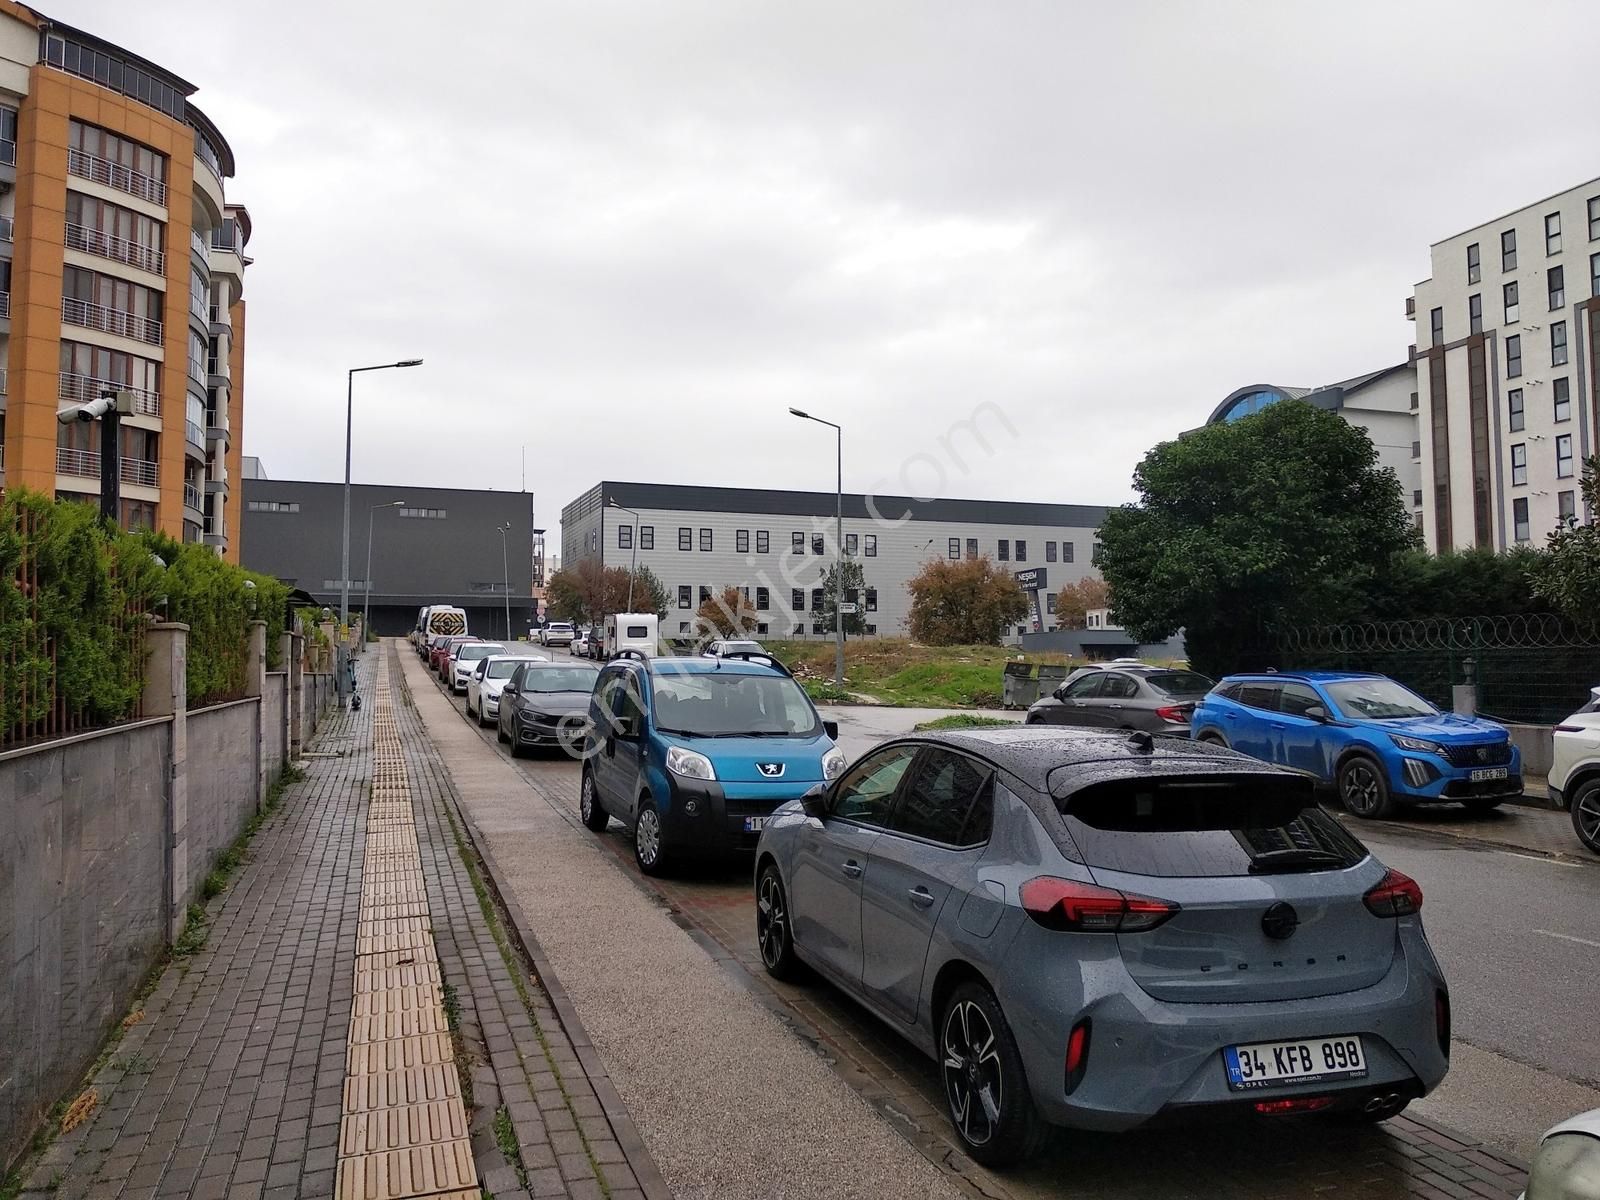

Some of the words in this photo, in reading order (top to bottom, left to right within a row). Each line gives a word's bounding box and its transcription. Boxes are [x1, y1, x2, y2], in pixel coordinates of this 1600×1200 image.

[1200, 954, 1346, 972] CORSA
[1239, 1050, 1266, 1078] 34
[1273, 1045, 1313, 1075] KFB
[1321, 1041, 1360, 1069] 898
[1231, 1068, 1241, 1077] TR
